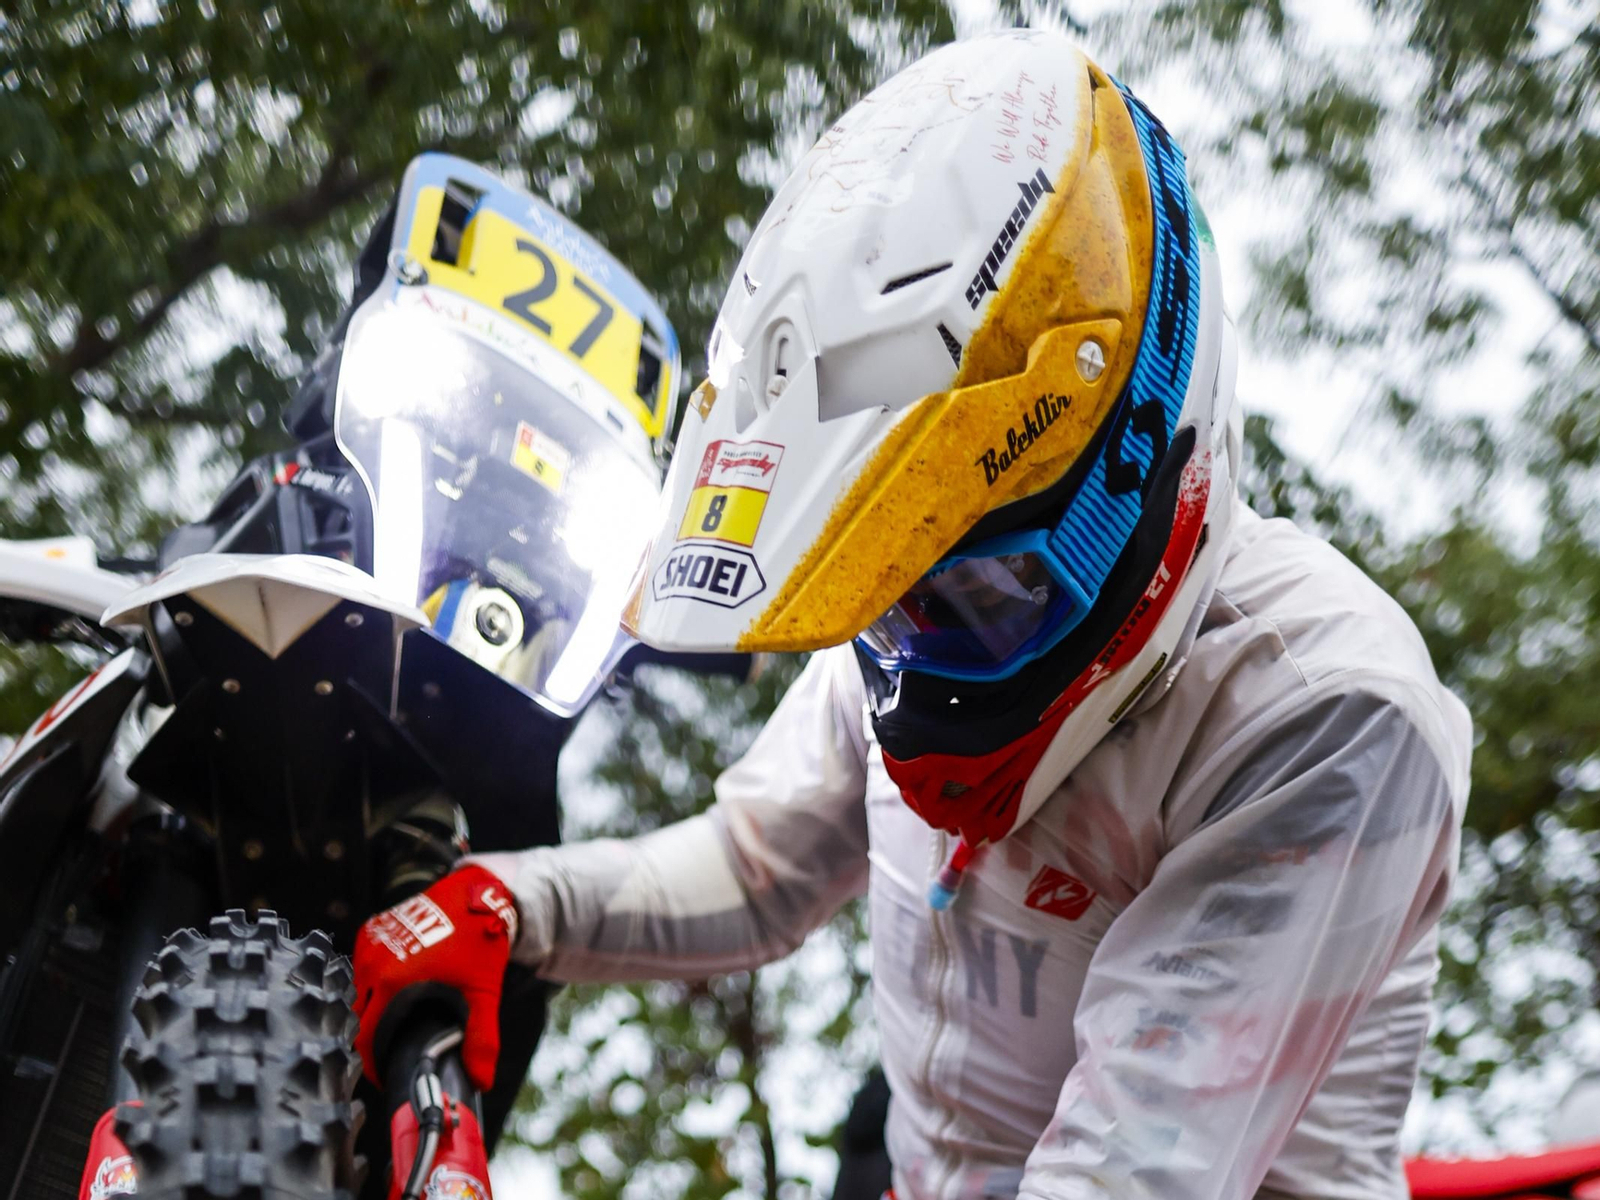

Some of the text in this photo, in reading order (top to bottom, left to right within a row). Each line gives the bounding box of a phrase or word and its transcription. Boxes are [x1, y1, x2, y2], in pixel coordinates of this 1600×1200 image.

[1026, 133, 1049, 162] Ride
[965, 167, 1056, 311] speedy
[502, 238, 614, 358] 27
[701, 494, 727, 532] 8
[660, 554, 748, 598] SHOEI
